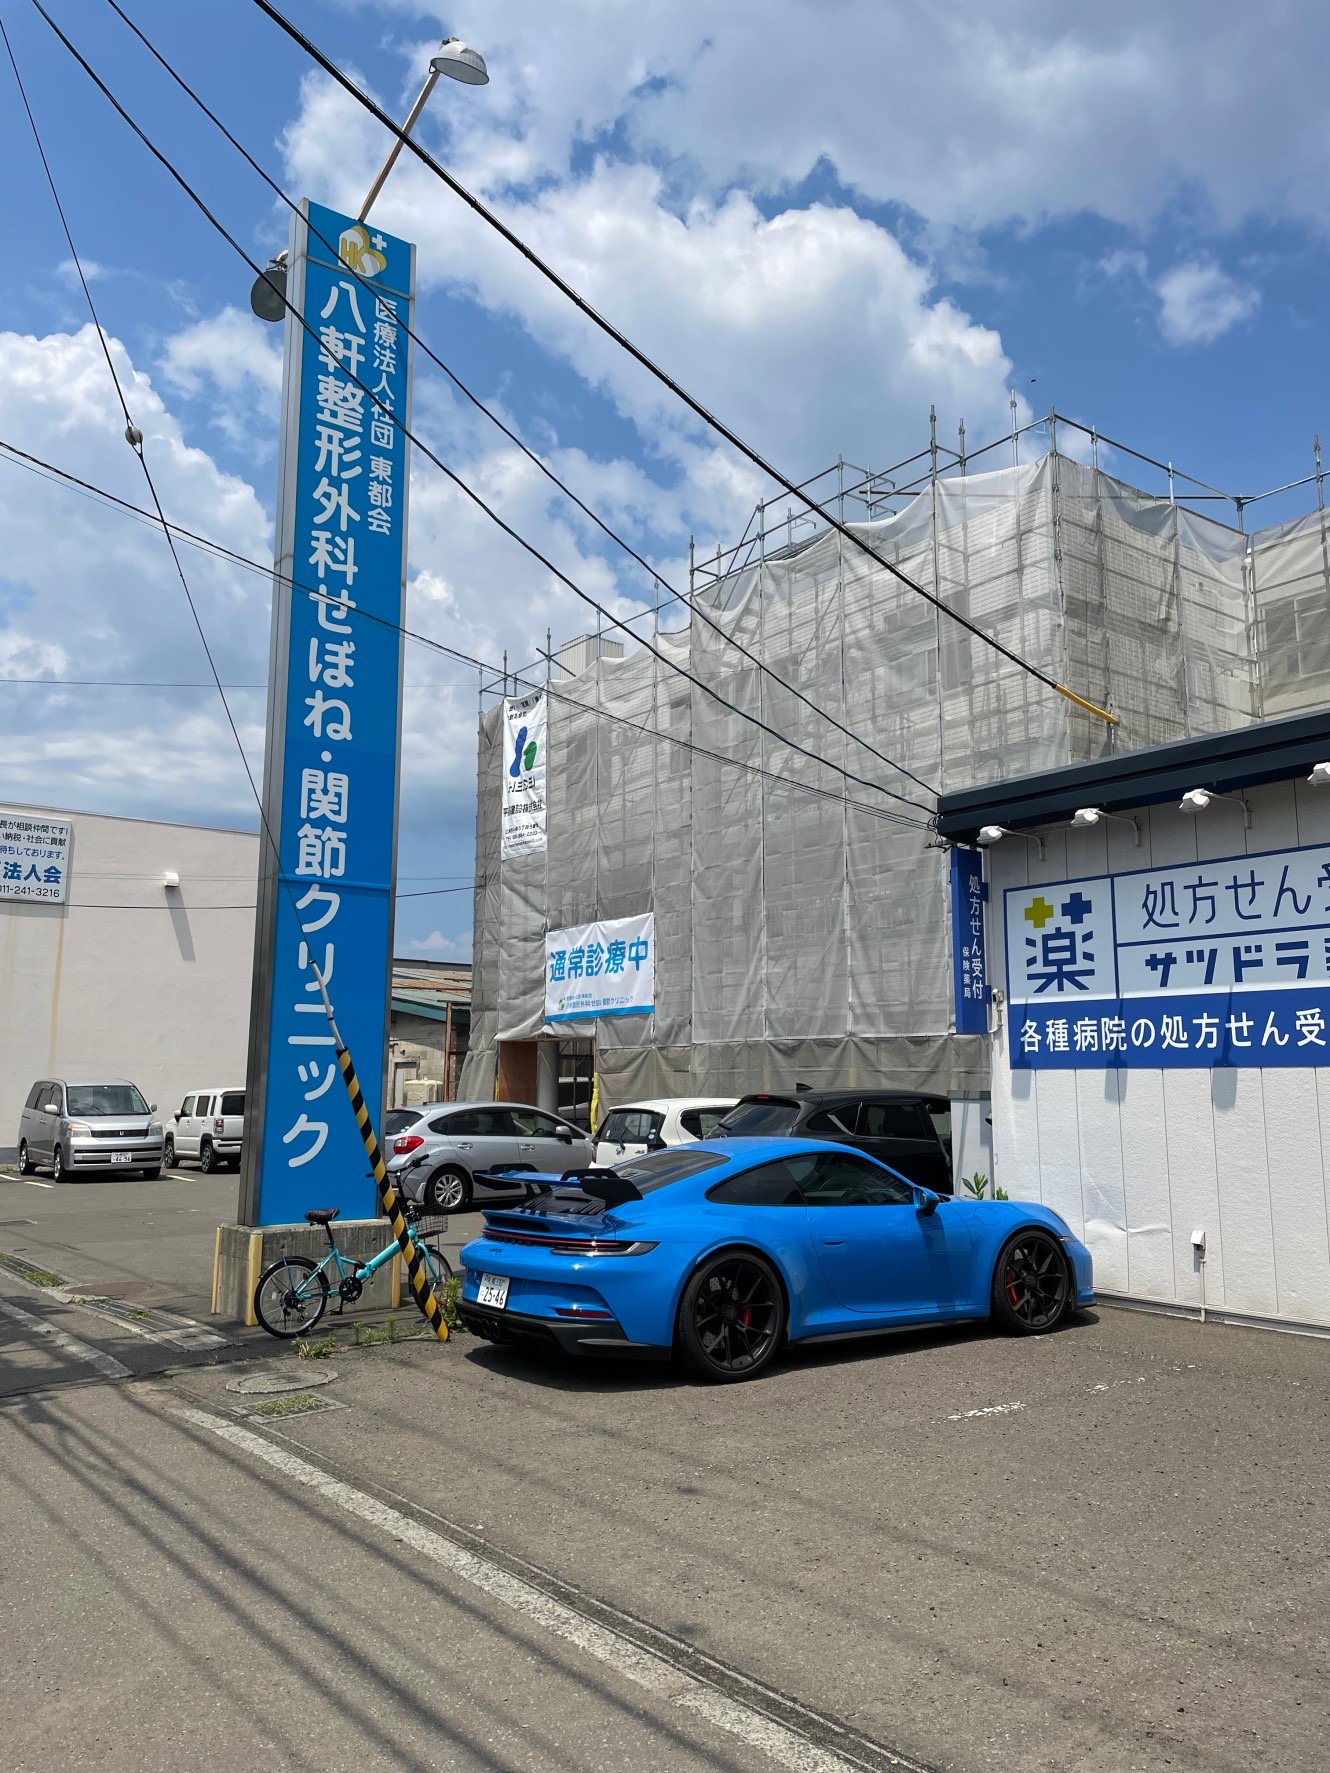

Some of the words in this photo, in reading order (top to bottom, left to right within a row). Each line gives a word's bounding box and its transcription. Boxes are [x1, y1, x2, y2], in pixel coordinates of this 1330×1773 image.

[371, 295, 398, 450] 医療法人社団
[367, 455, 393, 536] 東都会
[283, 281, 366, 1168] 八軒整形外科せぼね・関節クリニック
[0, 861, 62, 885] 法人会
[549, 936, 650, 983] 通常診療中
[969, 874, 983, 1000] 処方せん受付
[962, 946, 971, 999] 保険薬局
[1020, 1008, 1327, 1053] 各種病院の処方せん受
